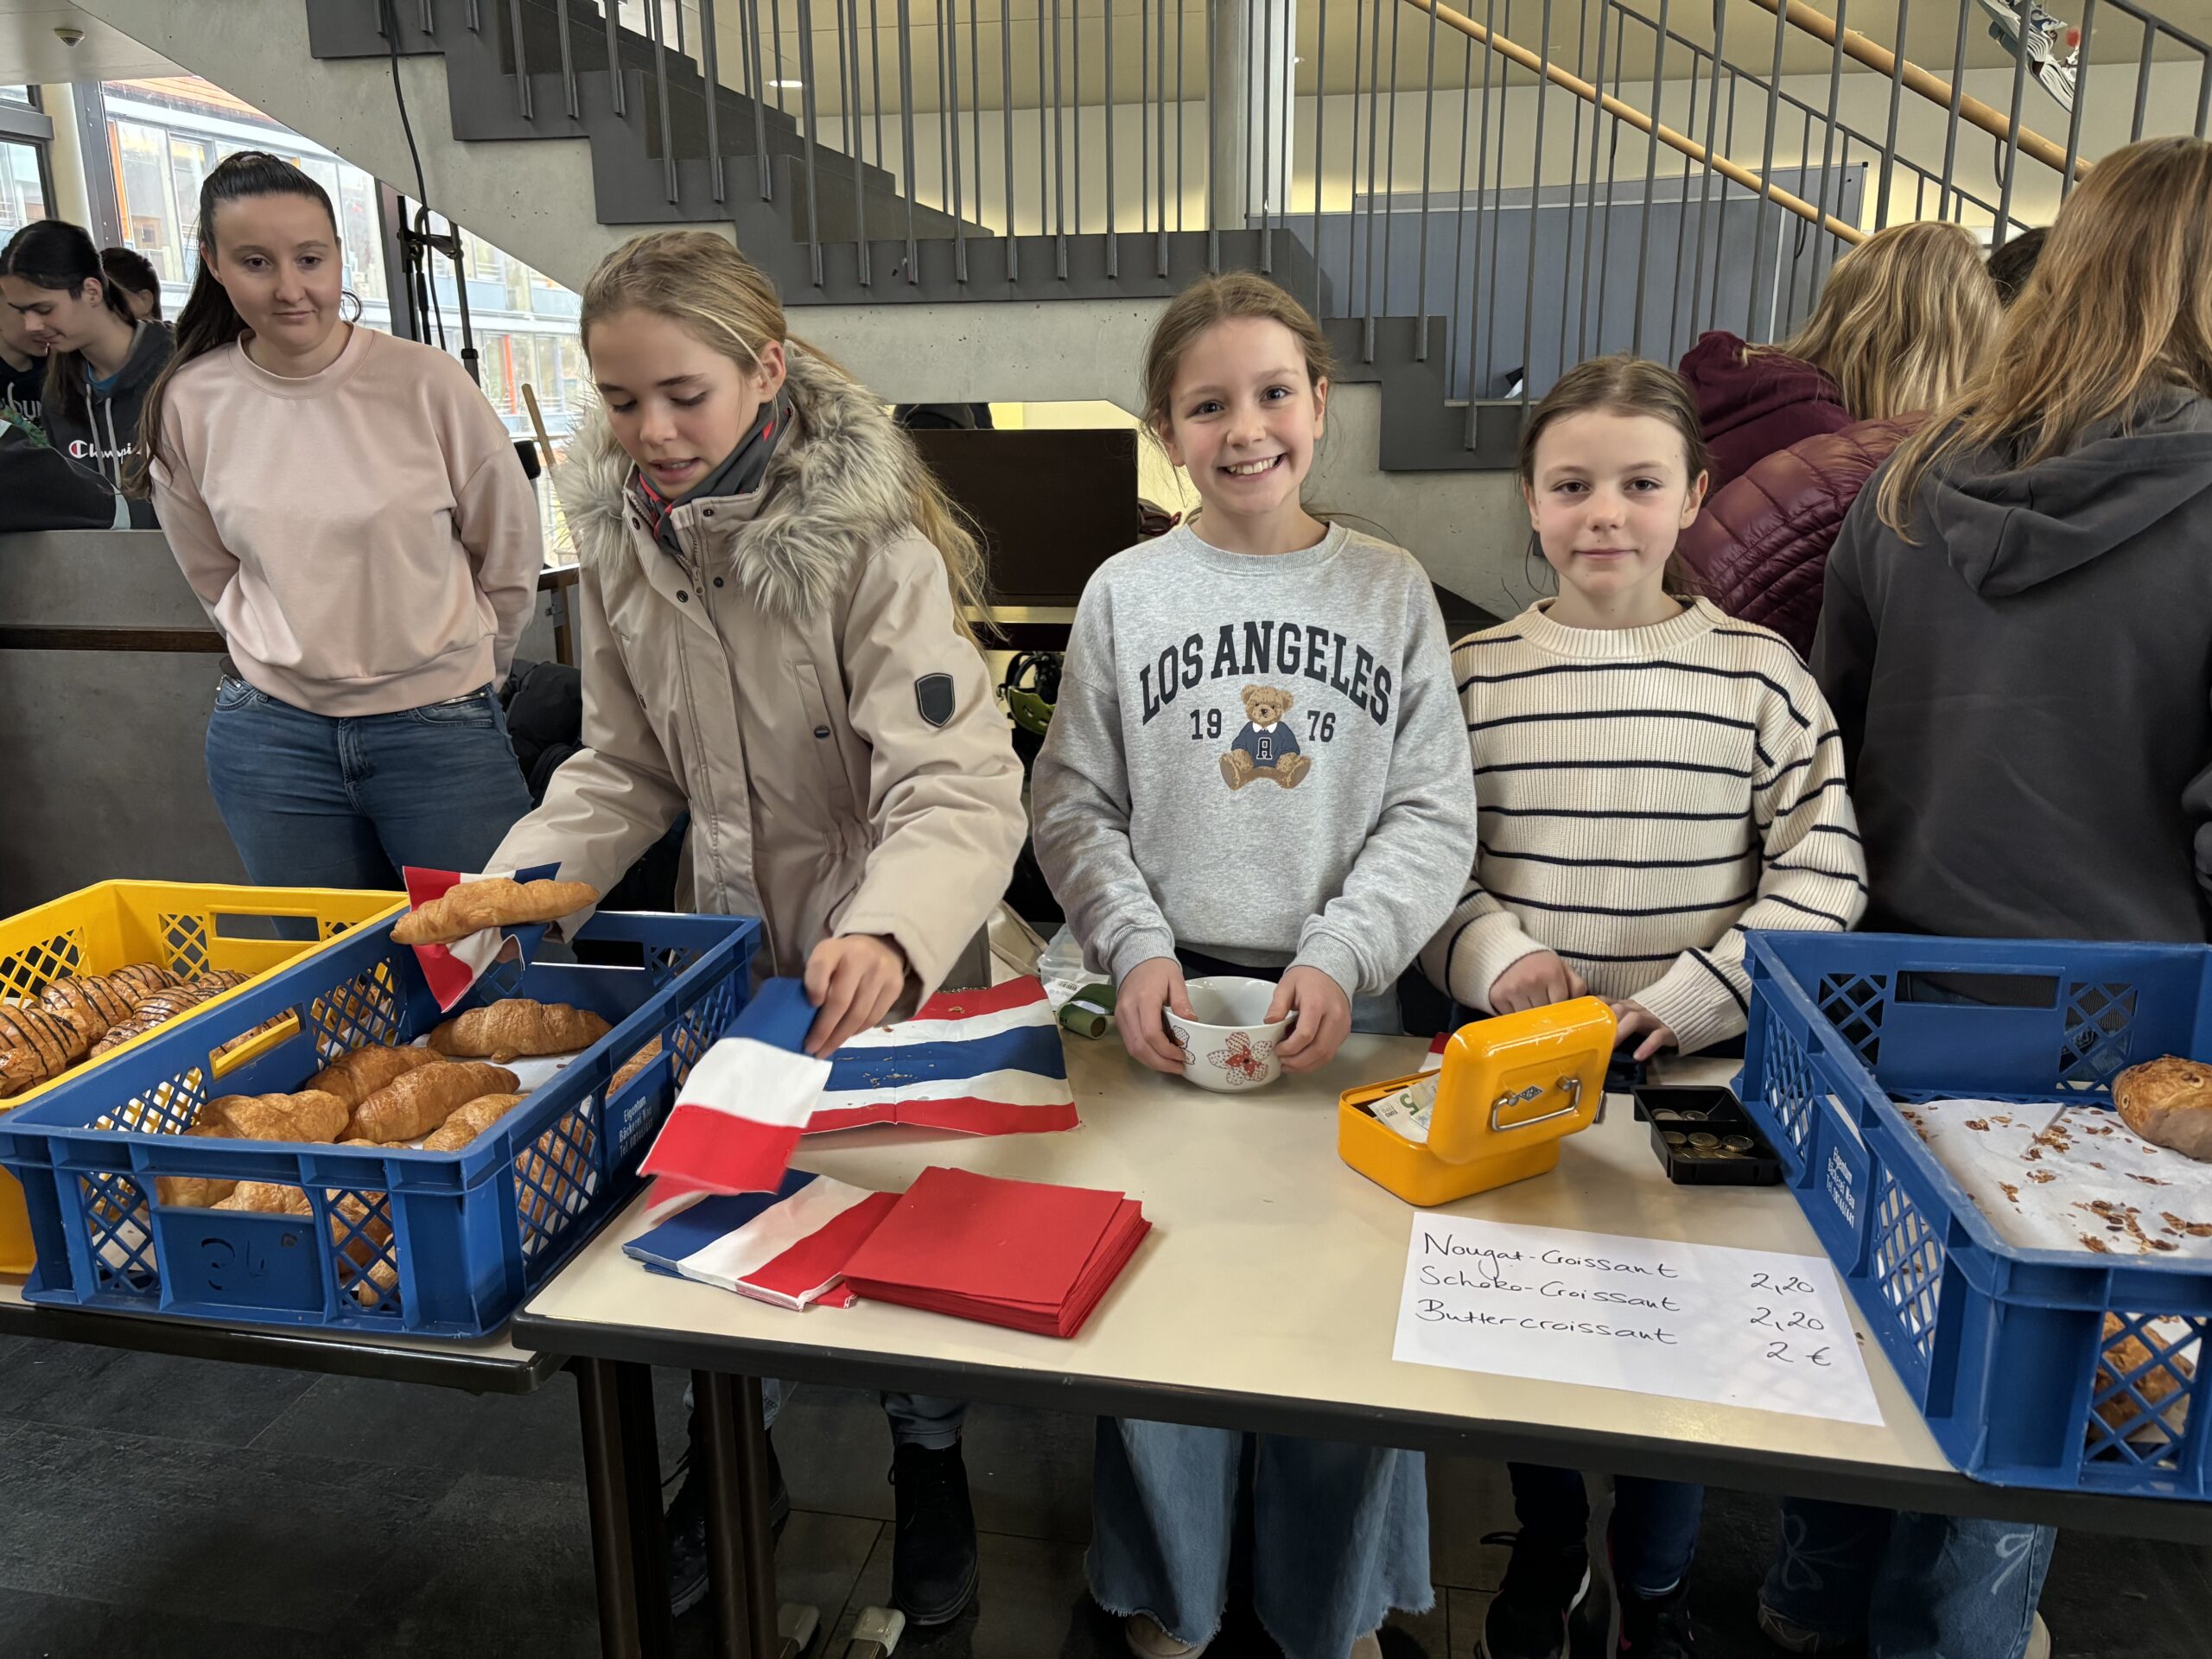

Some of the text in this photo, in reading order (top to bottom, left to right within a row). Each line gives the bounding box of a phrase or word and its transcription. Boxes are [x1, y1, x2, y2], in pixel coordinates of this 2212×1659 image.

[69, 439, 143, 465] Chmpi
[1140, 620, 1392, 727] LOS ANGELES
[1190, 709, 1337, 743] 19 76
[1257, 737, 1273, 760] A
[624, 1096, 646, 1122] Eigentum
[1385, 1109, 1398, 1118] EURO
[1400, 1093, 1420, 1116] 5
[1833, 1146, 1853, 1185] Eigentum
[1827, 1157, 1855, 1210] Bäckerei Nau
[1419, 1265, 1681, 1312] Schoko-Croissant
[1751, 1273, 1815, 1296] 2,20
[1751, 1306, 1824, 1332] 2,20
[1766, 1341, 1832, 1366] 2 €
